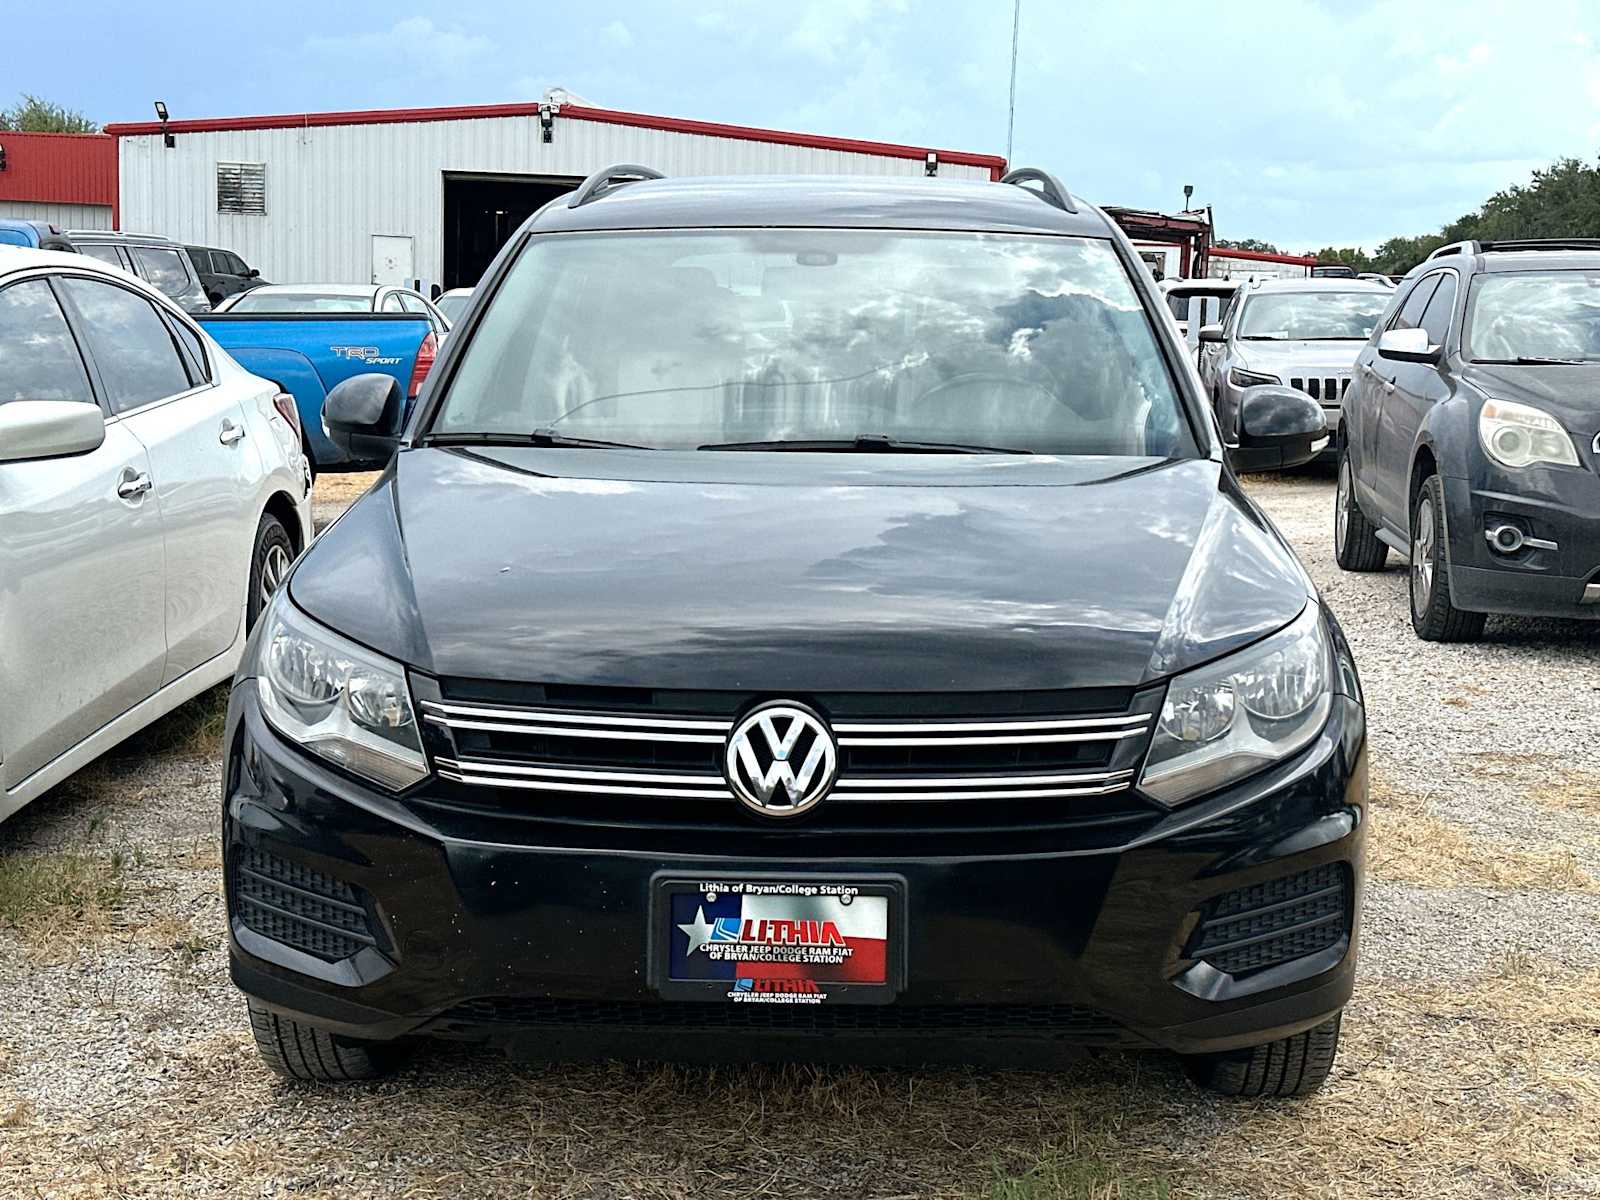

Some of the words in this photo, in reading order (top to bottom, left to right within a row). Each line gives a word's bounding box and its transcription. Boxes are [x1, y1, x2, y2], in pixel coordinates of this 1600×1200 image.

[330, 346, 379, 360] TRD
[365, 357, 403, 365] SPORT
[700, 883, 729, 893] Lithia
[732, 884, 744, 893] of
[746, 884, 818, 895] Bryan/College
[820, 885, 859, 895] Station
[740, 918, 847, 946] LITHIA
[700, 943, 747, 953] CHRYSLER
[749, 945, 772, 954] JEEP
[773, 946, 807, 955] DODGE
[808, 947, 831, 956] RAM
[833, 948, 854, 957] FIAT
[709, 951, 723, 960] OF
[724, 952, 801, 963] BRYAN/COLLEGE
[803, 954, 844, 964] STATION
[753, 978, 821, 993] LITHIA
